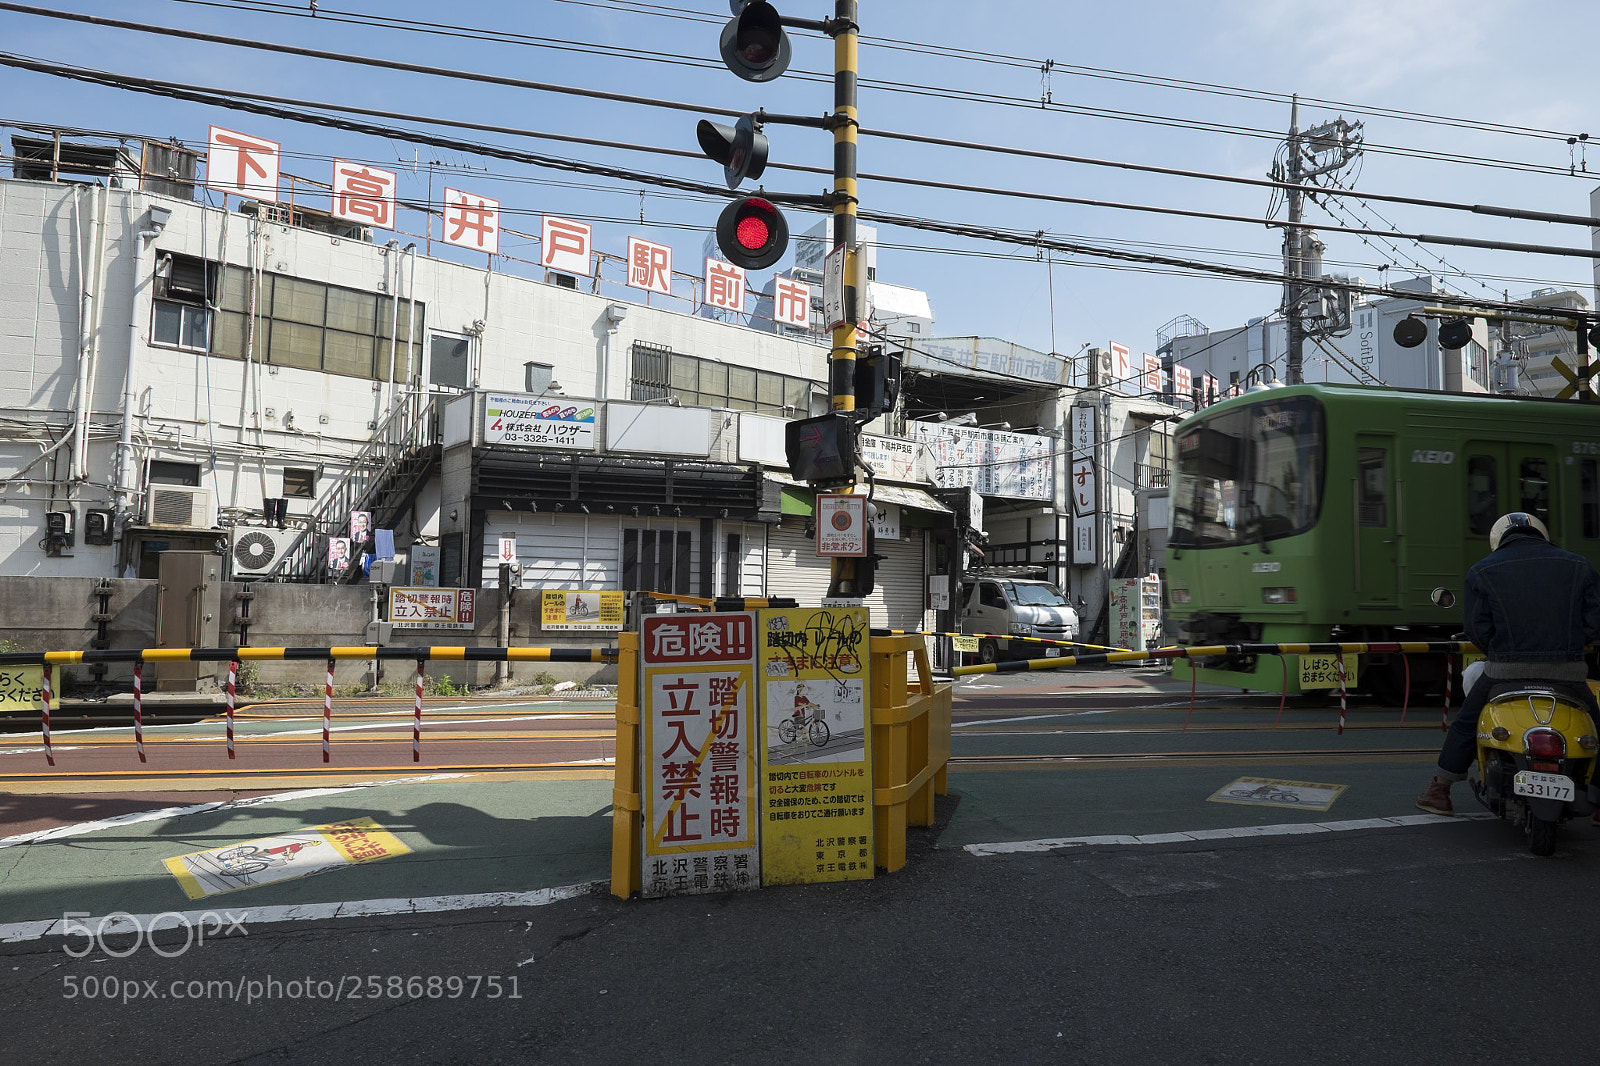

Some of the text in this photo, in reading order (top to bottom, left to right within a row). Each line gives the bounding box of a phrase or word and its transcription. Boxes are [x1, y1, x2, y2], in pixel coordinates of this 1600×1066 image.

[922, 343, 1057, 381] 下高井戸駅前市場
[1361, 331, 1374, 385] SoftBank
[499, 409, 536, 419] HOUZER
[506, 422, 591, 435] 株式会社 ハウザー
[505, 433, 575, 444] 03-3325-1411
[880, 440, 912, 454] 下高井戸支店
[1411, 449, 1454, 464] KEIO
[1074, 466, 1092, 506] すし
[822, 542, 861, 551] 非常ボタン
[395, 594, 452, 604] 踏切警報時
[394, 605, 452, 618] 立入禁止
[460, 592, 472, 622] 危険!!
[651, 621, 747, 657] 危険!!
[767, 631, 808, 647] 踏切内
[1303, 659, 1338, 670] しばらく
[661, 678, 702, 843] 立入禁止
[709, 677, 740, 838] 踏切警報時
[768, 768, 864, 781] 踏切内で自転車のハンドルを
[769, 783, 836, 795] 切ると大変危険です
[1527, 784, 1570, 799] 33177
[769, 794, 864, 808] 安全確保のため、この踏切では
[769, 807, 865, 821] 自転車をおりてご通行願います
[816, 836, 867, 847] 北沢警察署
[652, 854, 749, 876] 北沢警察署
